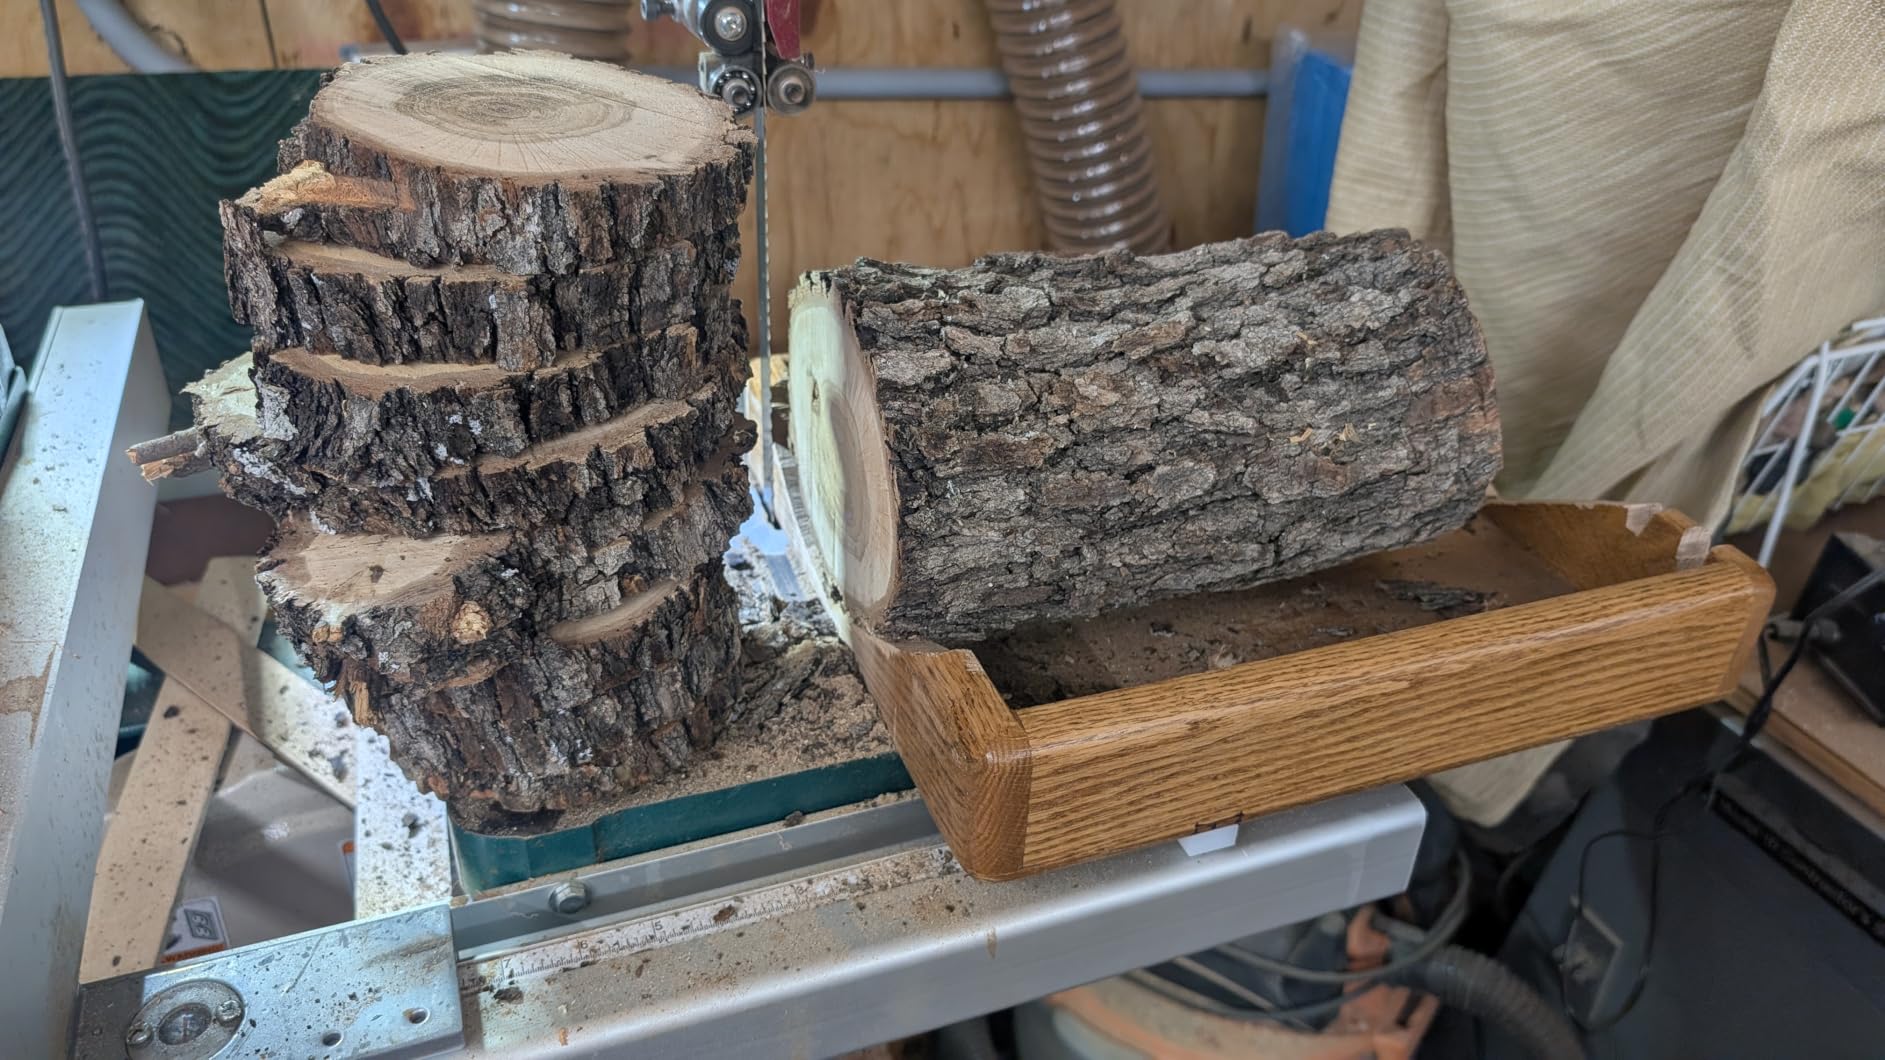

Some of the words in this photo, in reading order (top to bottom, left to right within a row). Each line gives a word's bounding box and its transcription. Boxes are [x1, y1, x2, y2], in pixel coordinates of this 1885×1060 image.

[503, 958, 512, 969] 7
[580, 939, 589, 949] 6
[654, 920, 663, 931] 5
